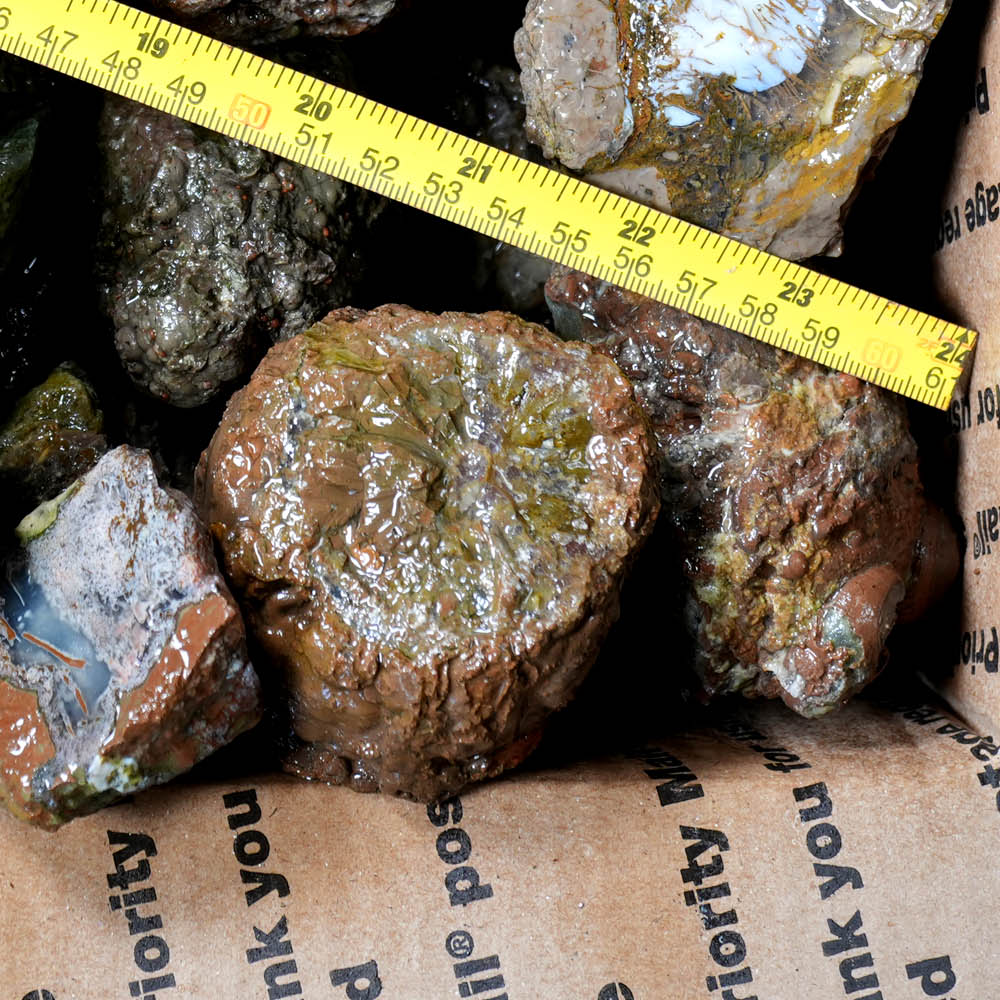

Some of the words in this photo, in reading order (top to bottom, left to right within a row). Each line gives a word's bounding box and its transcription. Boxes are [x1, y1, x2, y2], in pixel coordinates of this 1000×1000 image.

[36, 24, 79, 54] 47
[101, 50, 142, 81] 48
[166, 74, 207, 105] 49
[294, 122, 334, 155] 51
[359, 147, 401, 181] 52
[423, 172, 464, 205] 53
[486, 196, 527, 229] 54
[549, 221, 592, 254] 55
[613, 245, 654, 278] 56
[676, 270, 718, 300] 57
[738, 294, 779, 326] 58
[801, 318, 841, 350] 59
[924, 366, 961, 390] 6
[136, 32, 170, 59] 19
[294, 93, 333, 122] 20
[457, 156, 493, 184] 21
[617, 219, 657, 247] 22
[778, 281, 815, 308] 23
[965, 181, 1000, 234] age
[222, 788, 291, 907] you
[792, 781, 865, 900] you
[106, 830, 177, 1000] iority
[444, 930, 509, 1000] il®
[821, 910, 886, 1000] nk
